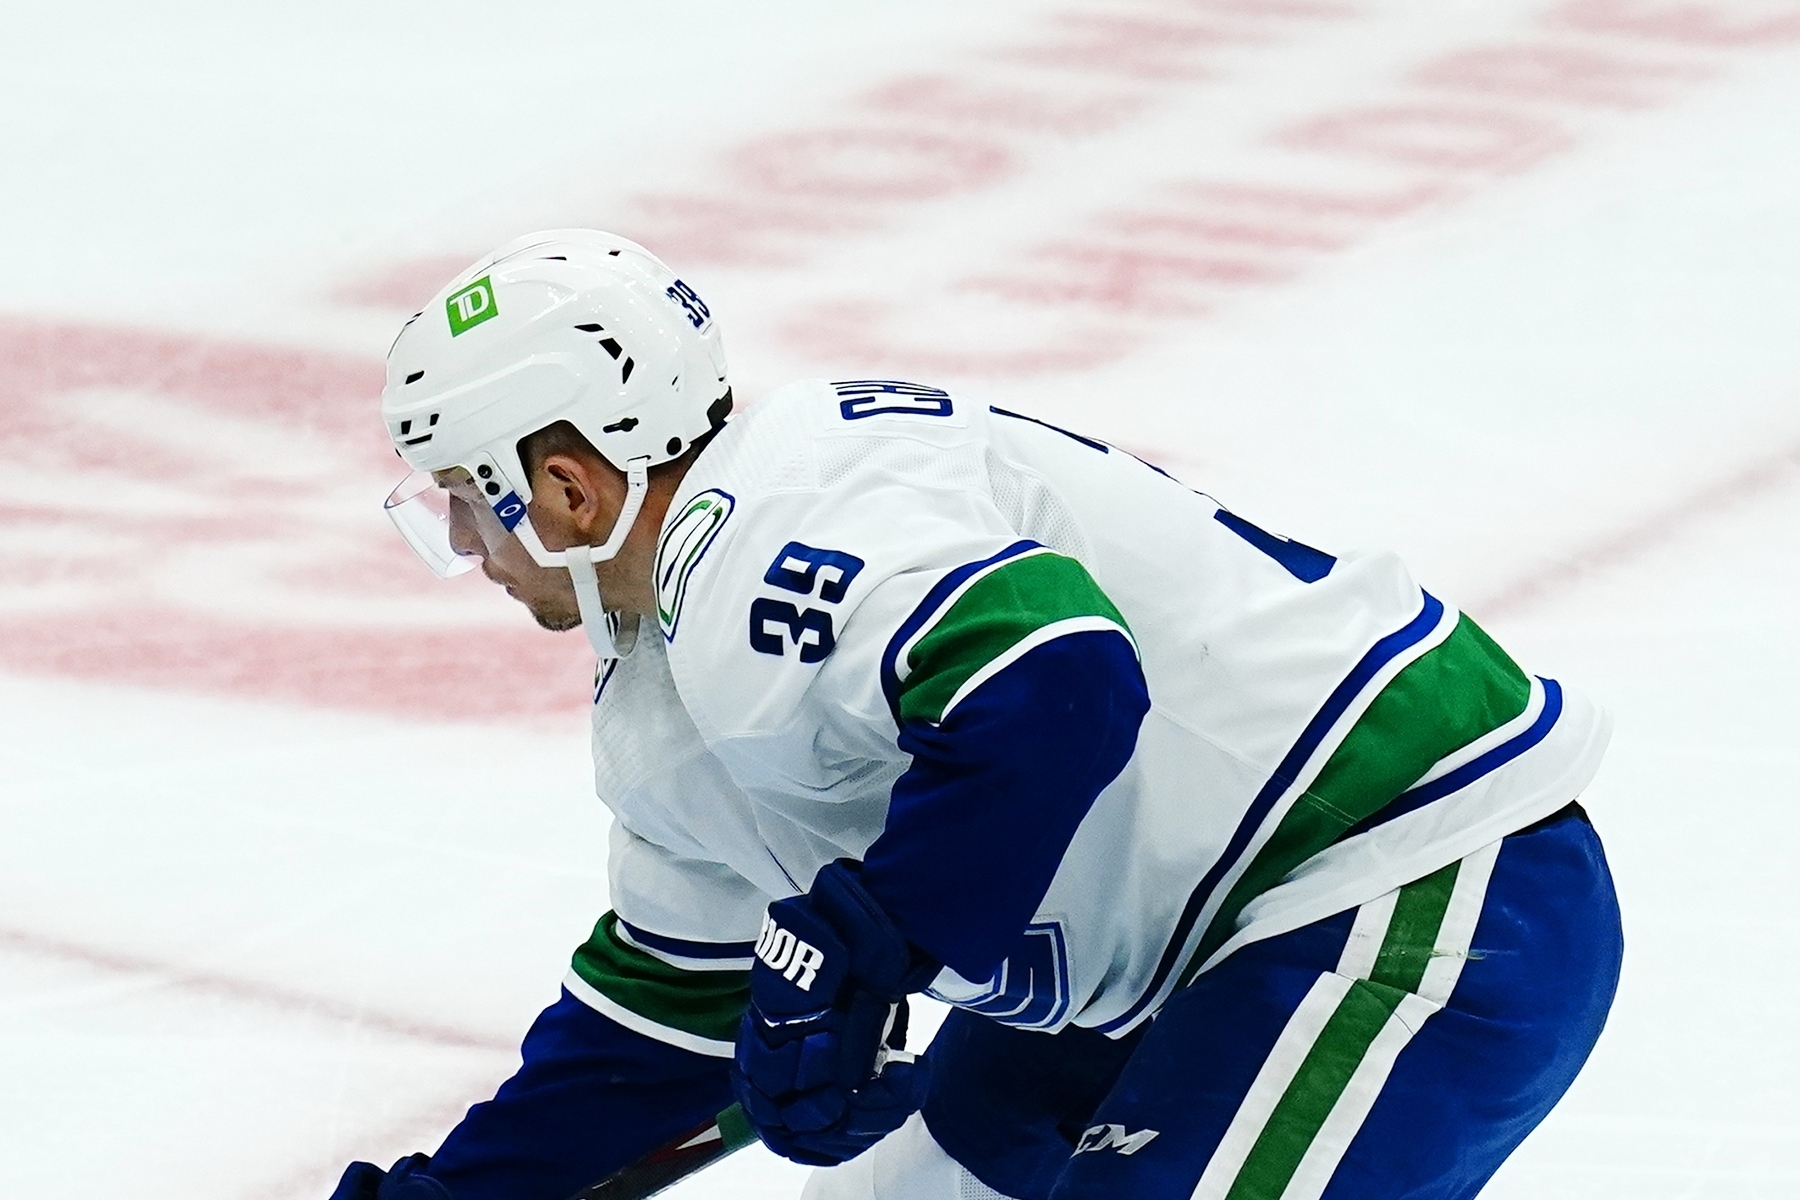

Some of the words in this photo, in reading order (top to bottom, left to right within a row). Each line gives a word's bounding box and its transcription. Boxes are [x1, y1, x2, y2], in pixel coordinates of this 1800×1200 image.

[449, 285, 490, 323] TD
[665, 279, 710, 328] 39
[749, 540, 865, 663] 39
